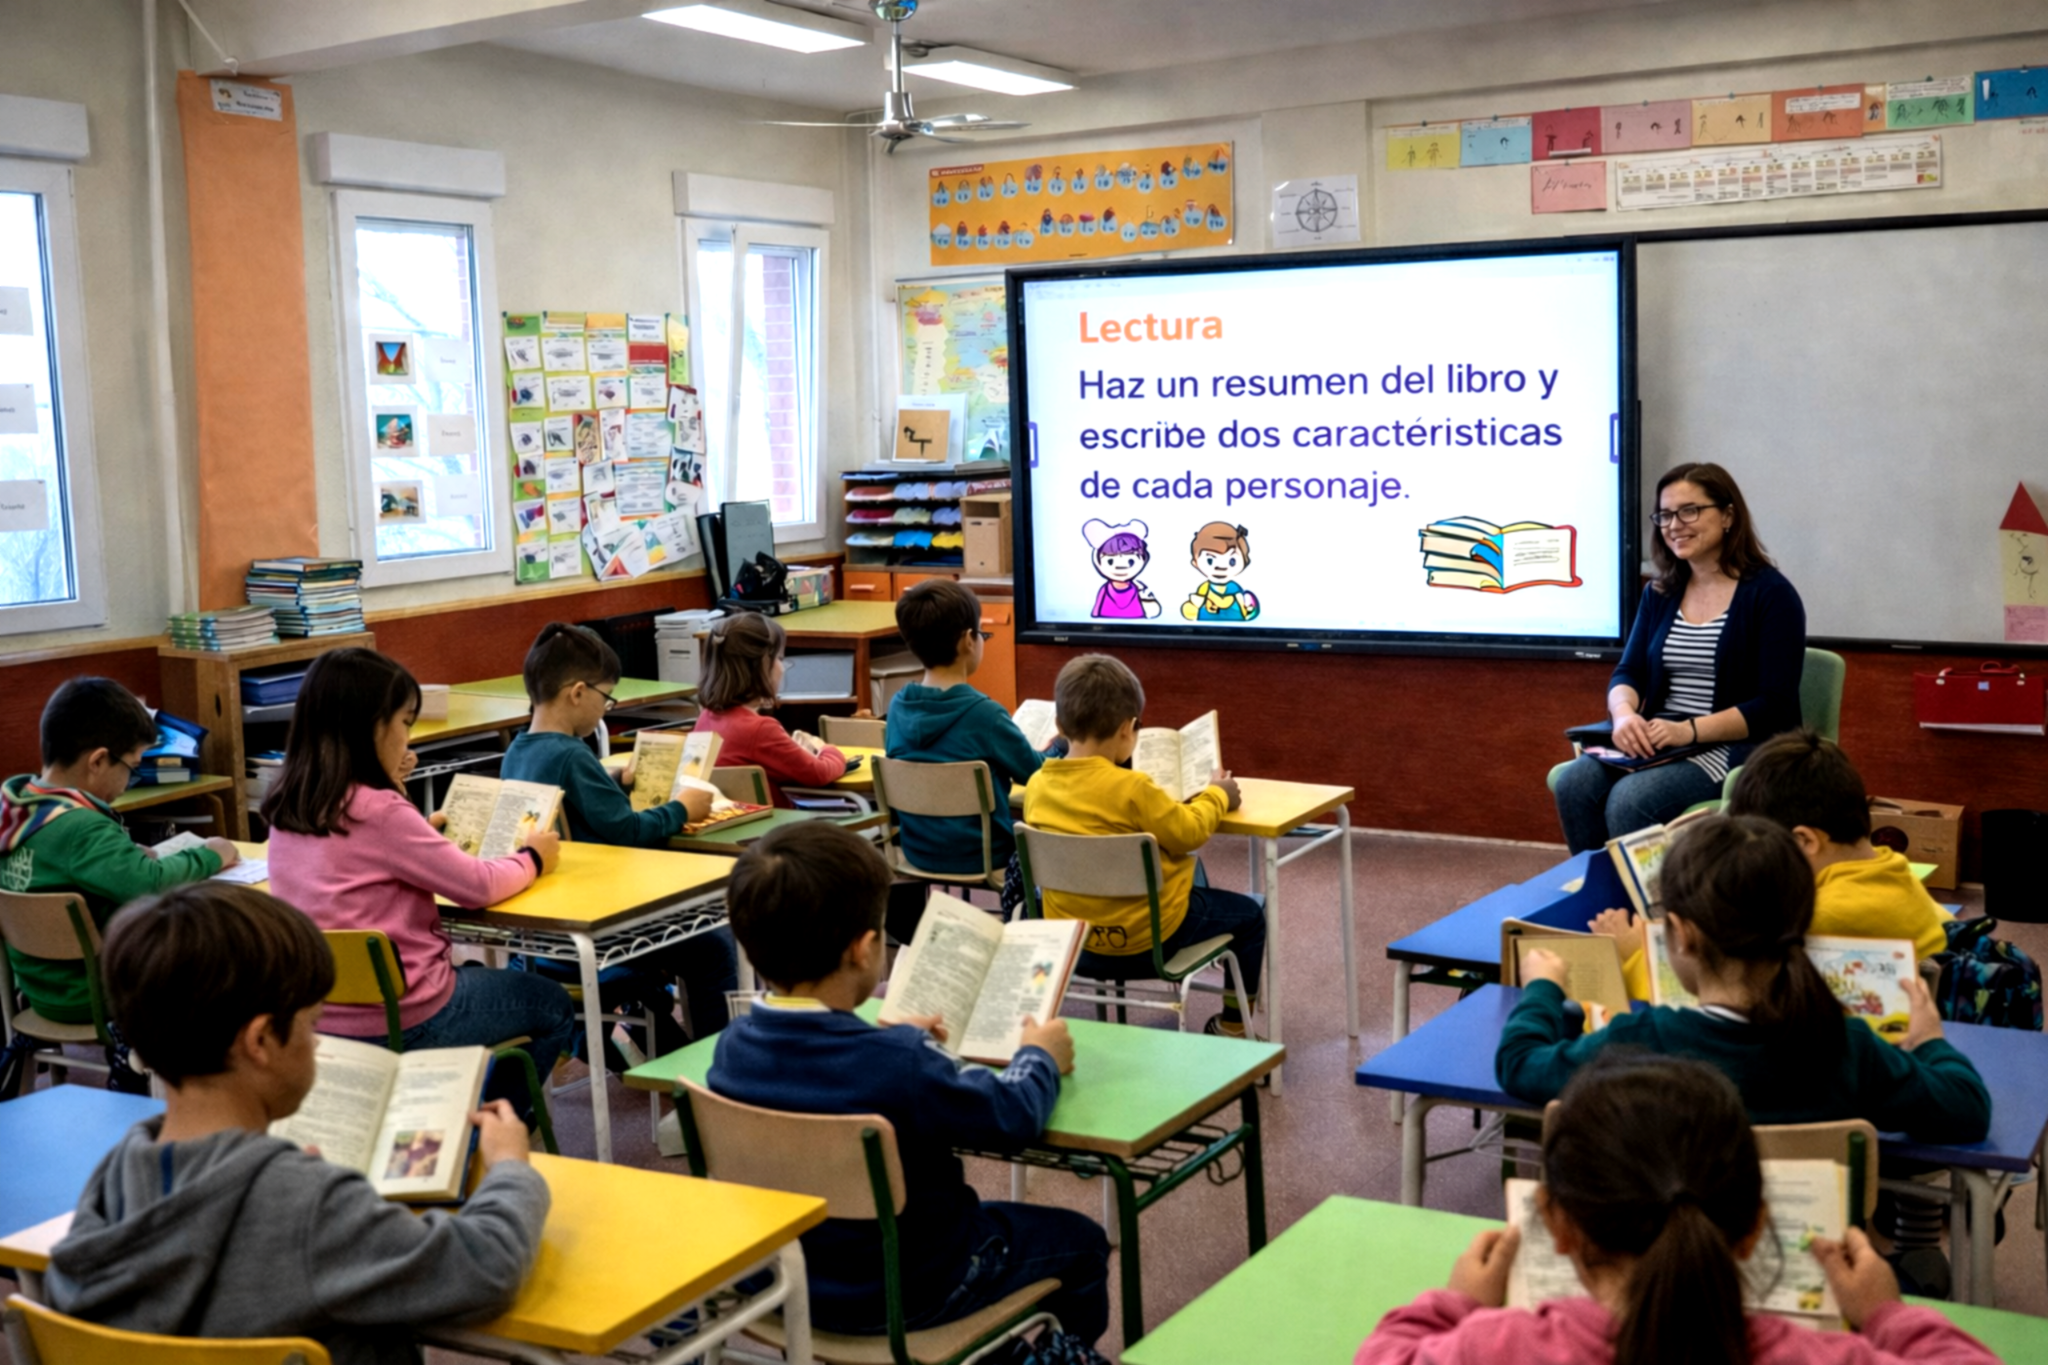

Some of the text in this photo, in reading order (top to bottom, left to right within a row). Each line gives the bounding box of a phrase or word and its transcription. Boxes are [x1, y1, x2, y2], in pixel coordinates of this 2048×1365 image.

[1079, 311, 1223, 343] Lectura
[1079, 363, 1559, 401] Haz un resumen del libro y
[1079, 416, 1563, 451] escribe dos caractéristicas
[1079, 469, 1410, 508] de cada personaje.
